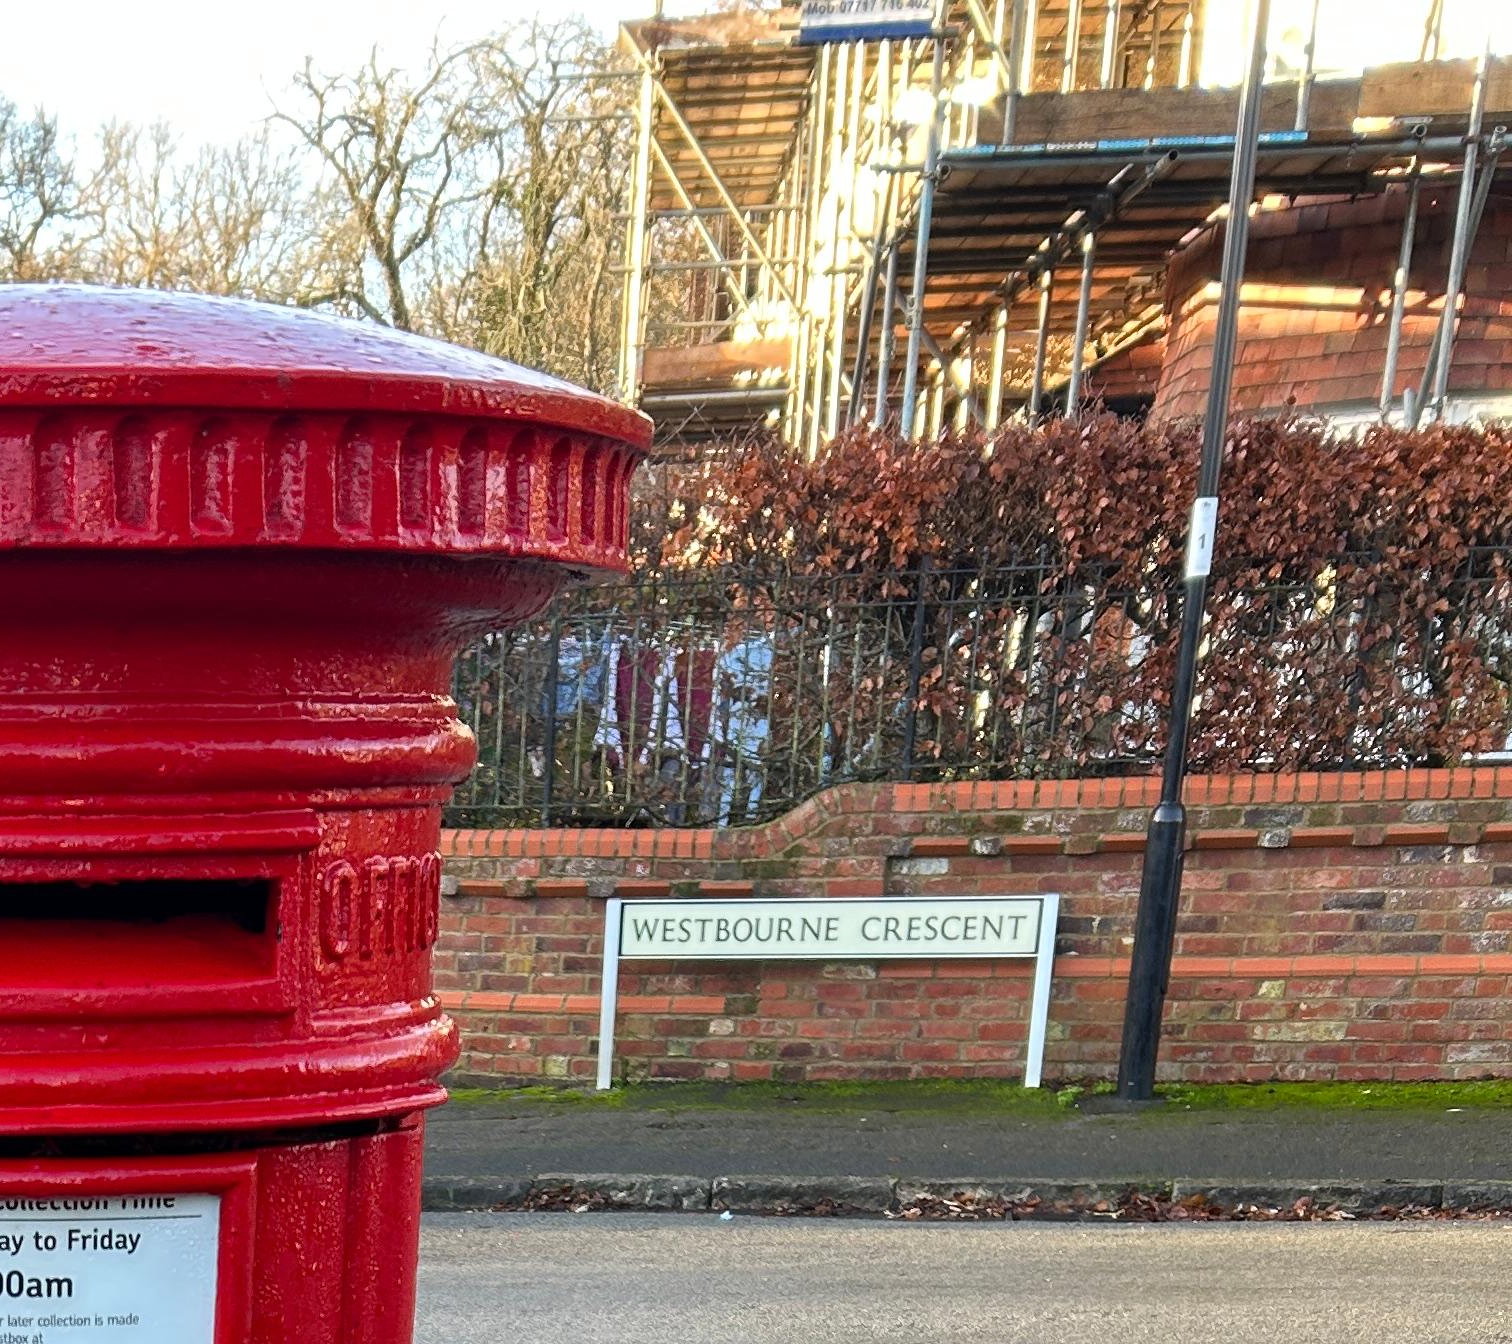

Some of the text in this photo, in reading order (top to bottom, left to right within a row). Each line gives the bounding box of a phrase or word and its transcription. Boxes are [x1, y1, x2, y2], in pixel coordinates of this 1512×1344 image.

[1198, 533, 1206, 550] 1
[320, 851, 442, 962] OFFIC
[632, 915, 1028, 942] WESTBOURNE CRESCENT
[33, 1231, 57, 1251] to
[67, 1228, 141, 1255] Friday
[8, 1314, 33, 1327] later
[37, 1314, 91, 1328] collection
[94, 1313, 104, 1327] is
[107, 1312, 139, 1326] made
[31, 1332, 44, 1344] at
